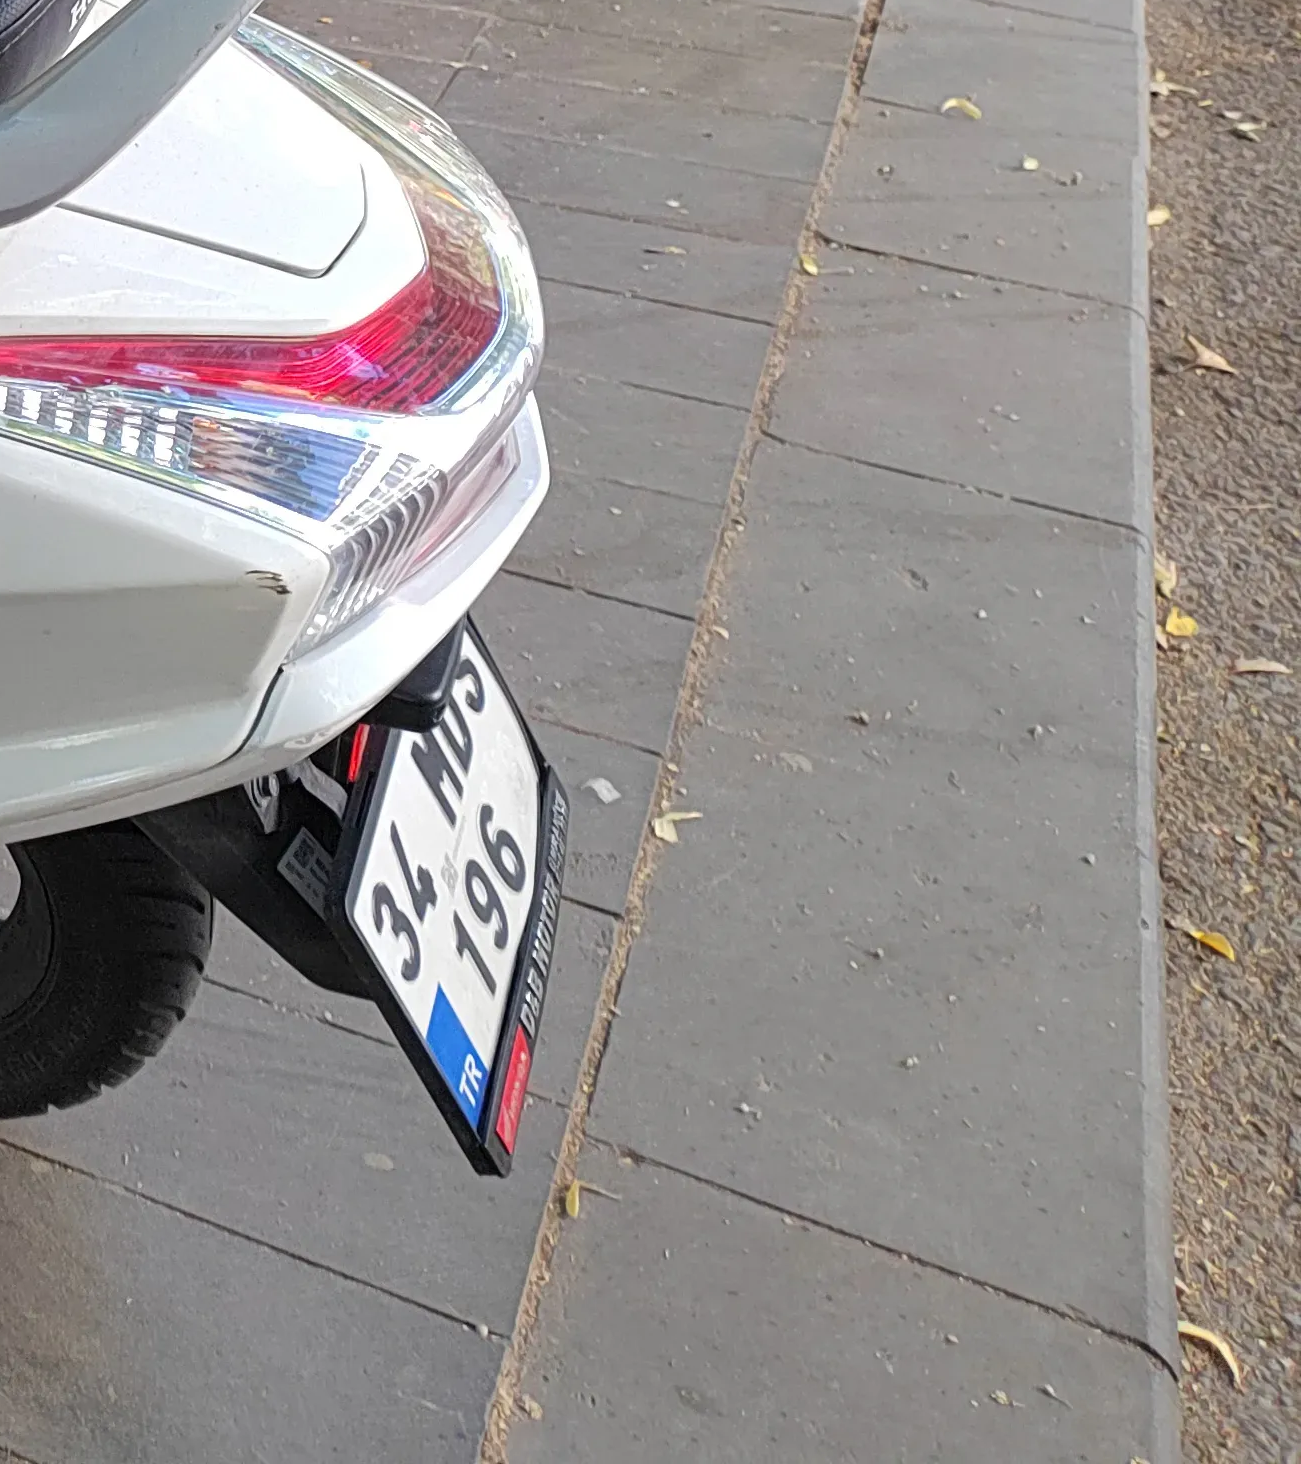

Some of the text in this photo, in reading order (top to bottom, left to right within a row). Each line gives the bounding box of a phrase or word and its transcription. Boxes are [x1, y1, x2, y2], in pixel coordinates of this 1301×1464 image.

[372, 819, 438, 982] 34
[452, 802, 527, 997] 196
[531, 871, 561, 979] MOTOR
[519, 967, 544, 1039] D&B
[458, 1053, 483, 1107] TR
